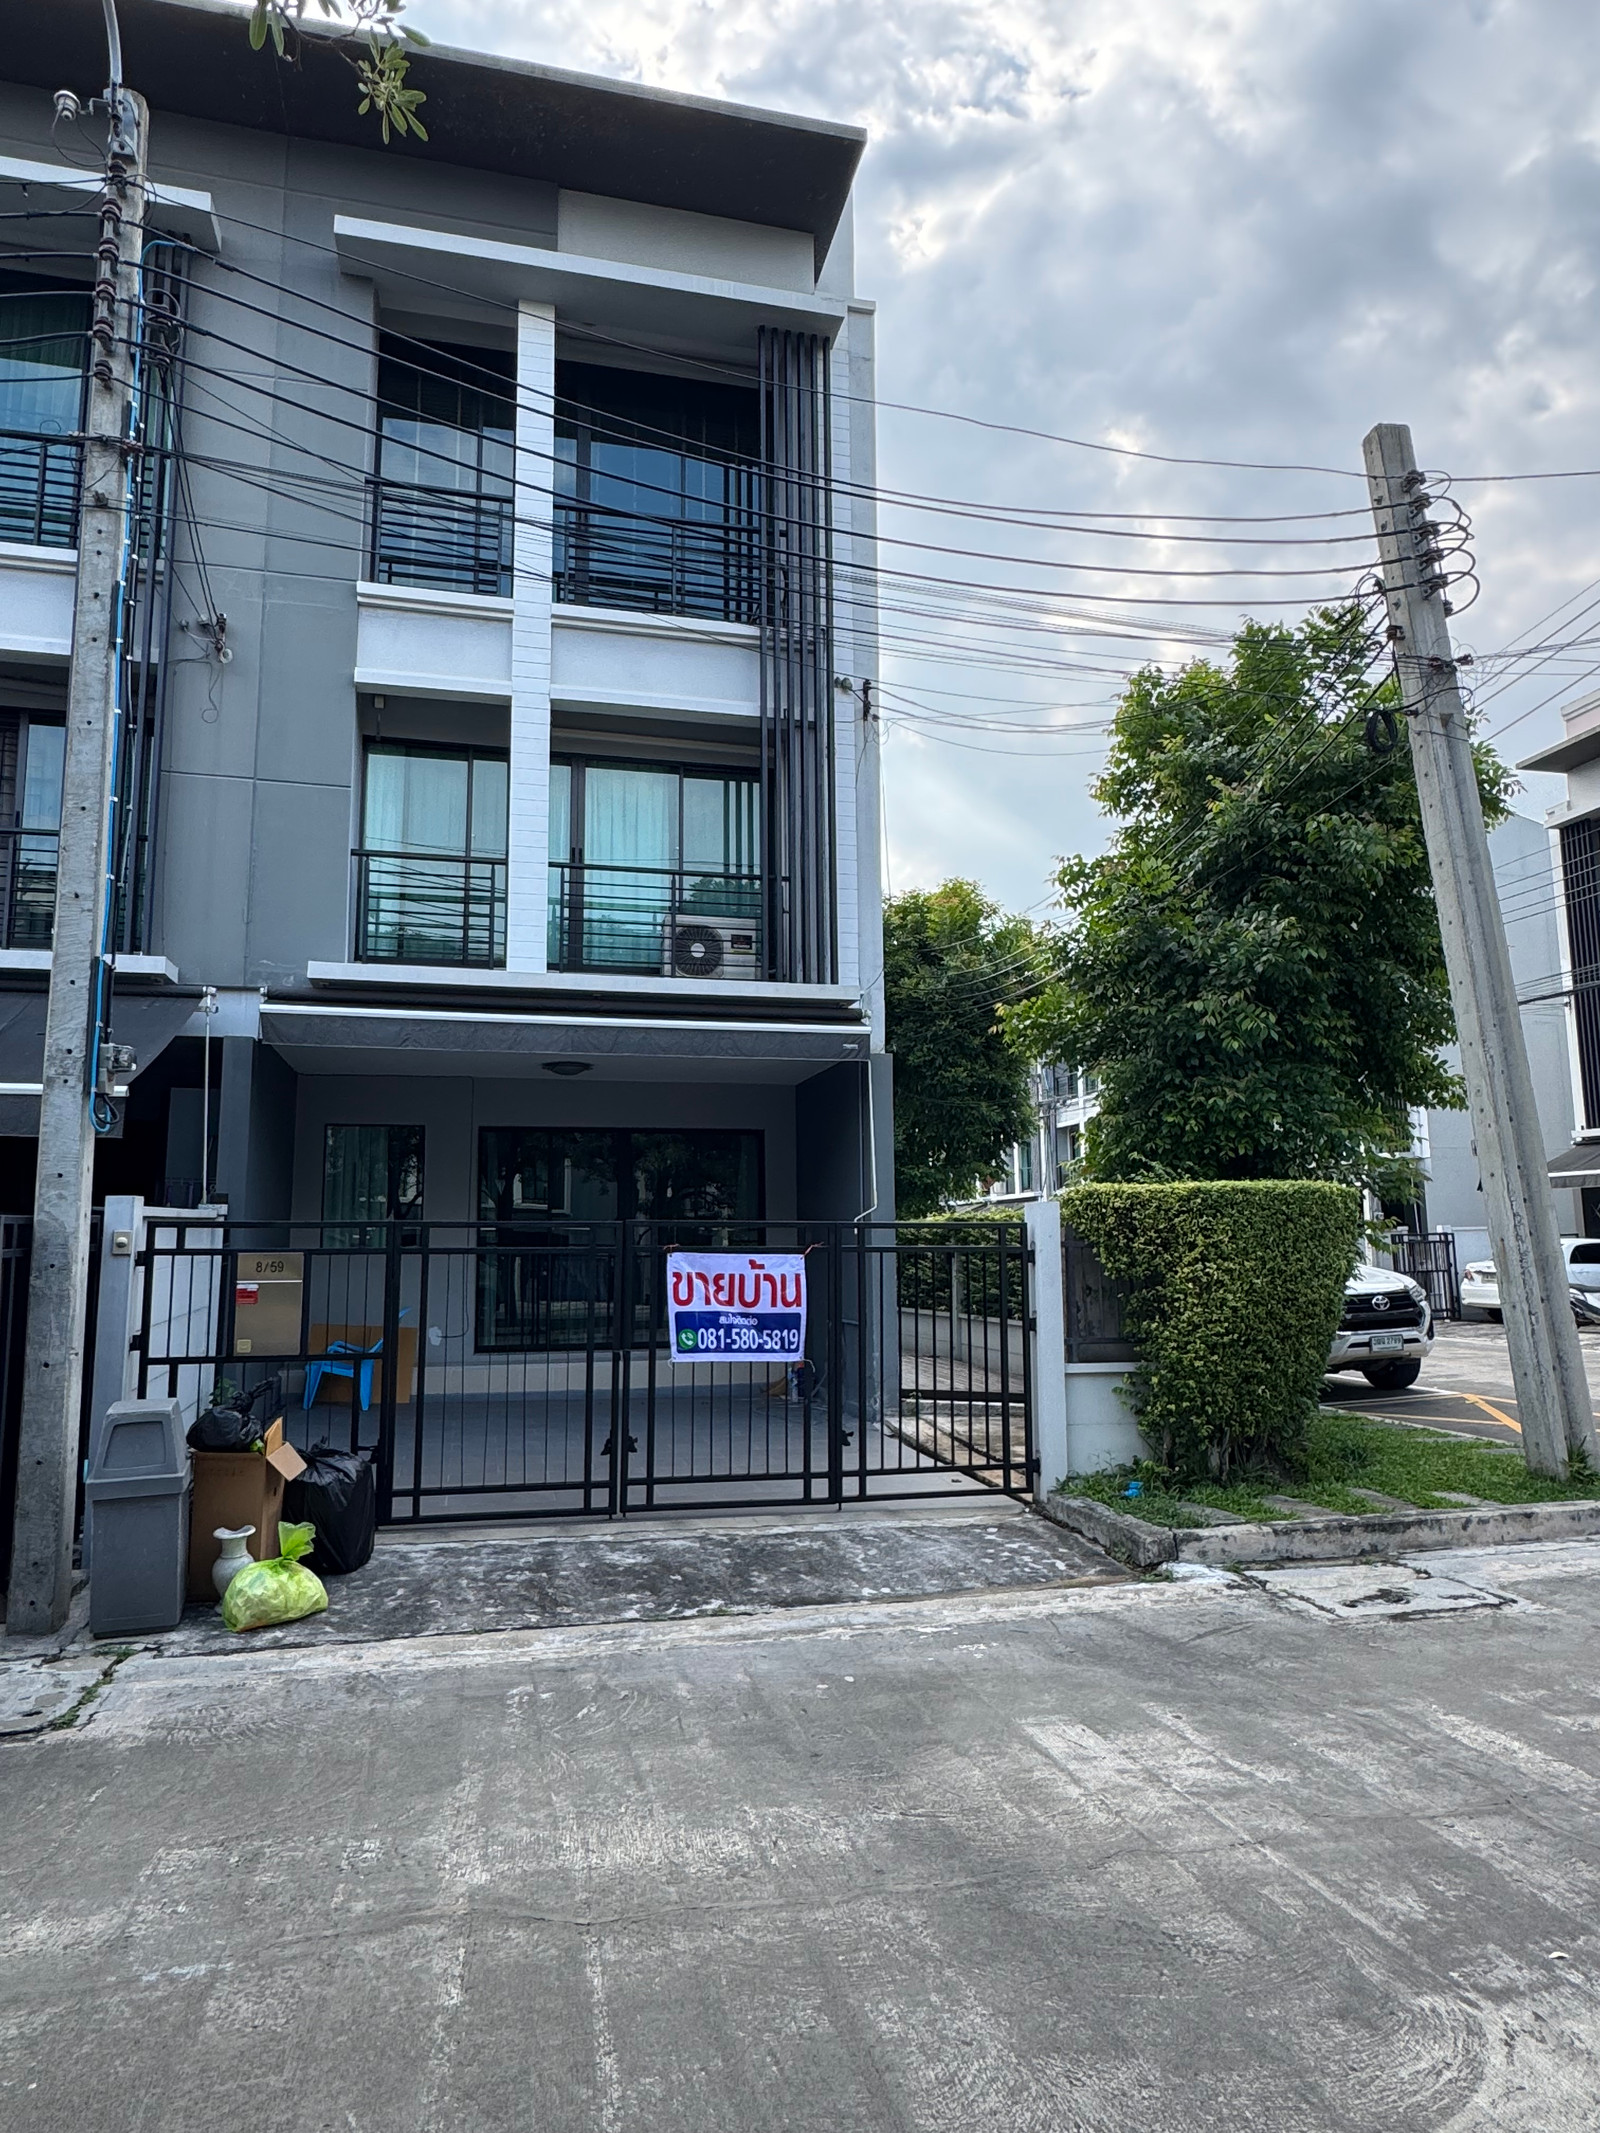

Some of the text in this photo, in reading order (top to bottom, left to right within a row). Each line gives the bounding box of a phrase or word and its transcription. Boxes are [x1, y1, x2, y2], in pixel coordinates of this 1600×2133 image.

[255, 1260, 285, 1273] 8/59
[672, 1259, 802, 1308] ขายบ้าน
[697, 1327, 799, 1350] 081-580-5819
